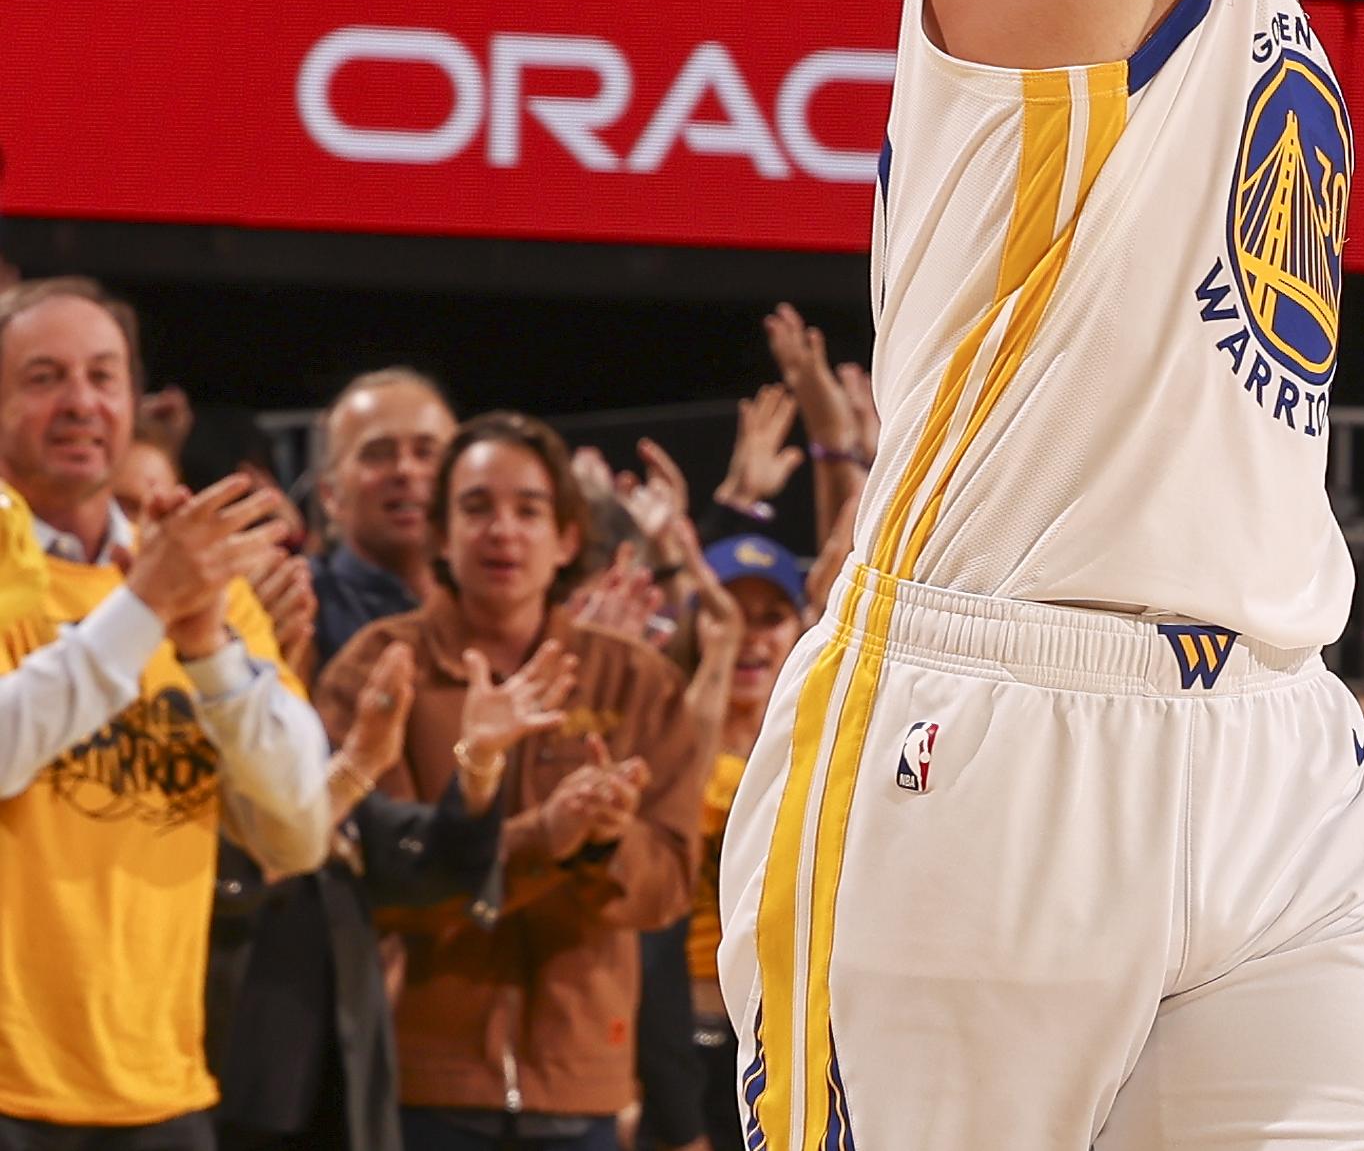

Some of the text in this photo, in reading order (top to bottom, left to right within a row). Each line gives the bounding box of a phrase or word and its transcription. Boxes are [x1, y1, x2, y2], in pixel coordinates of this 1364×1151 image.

[296, 24, 896, 183] ORAC
[1314, 145, 1347, 257] 30
[899, 773, 916, 788] NBA
